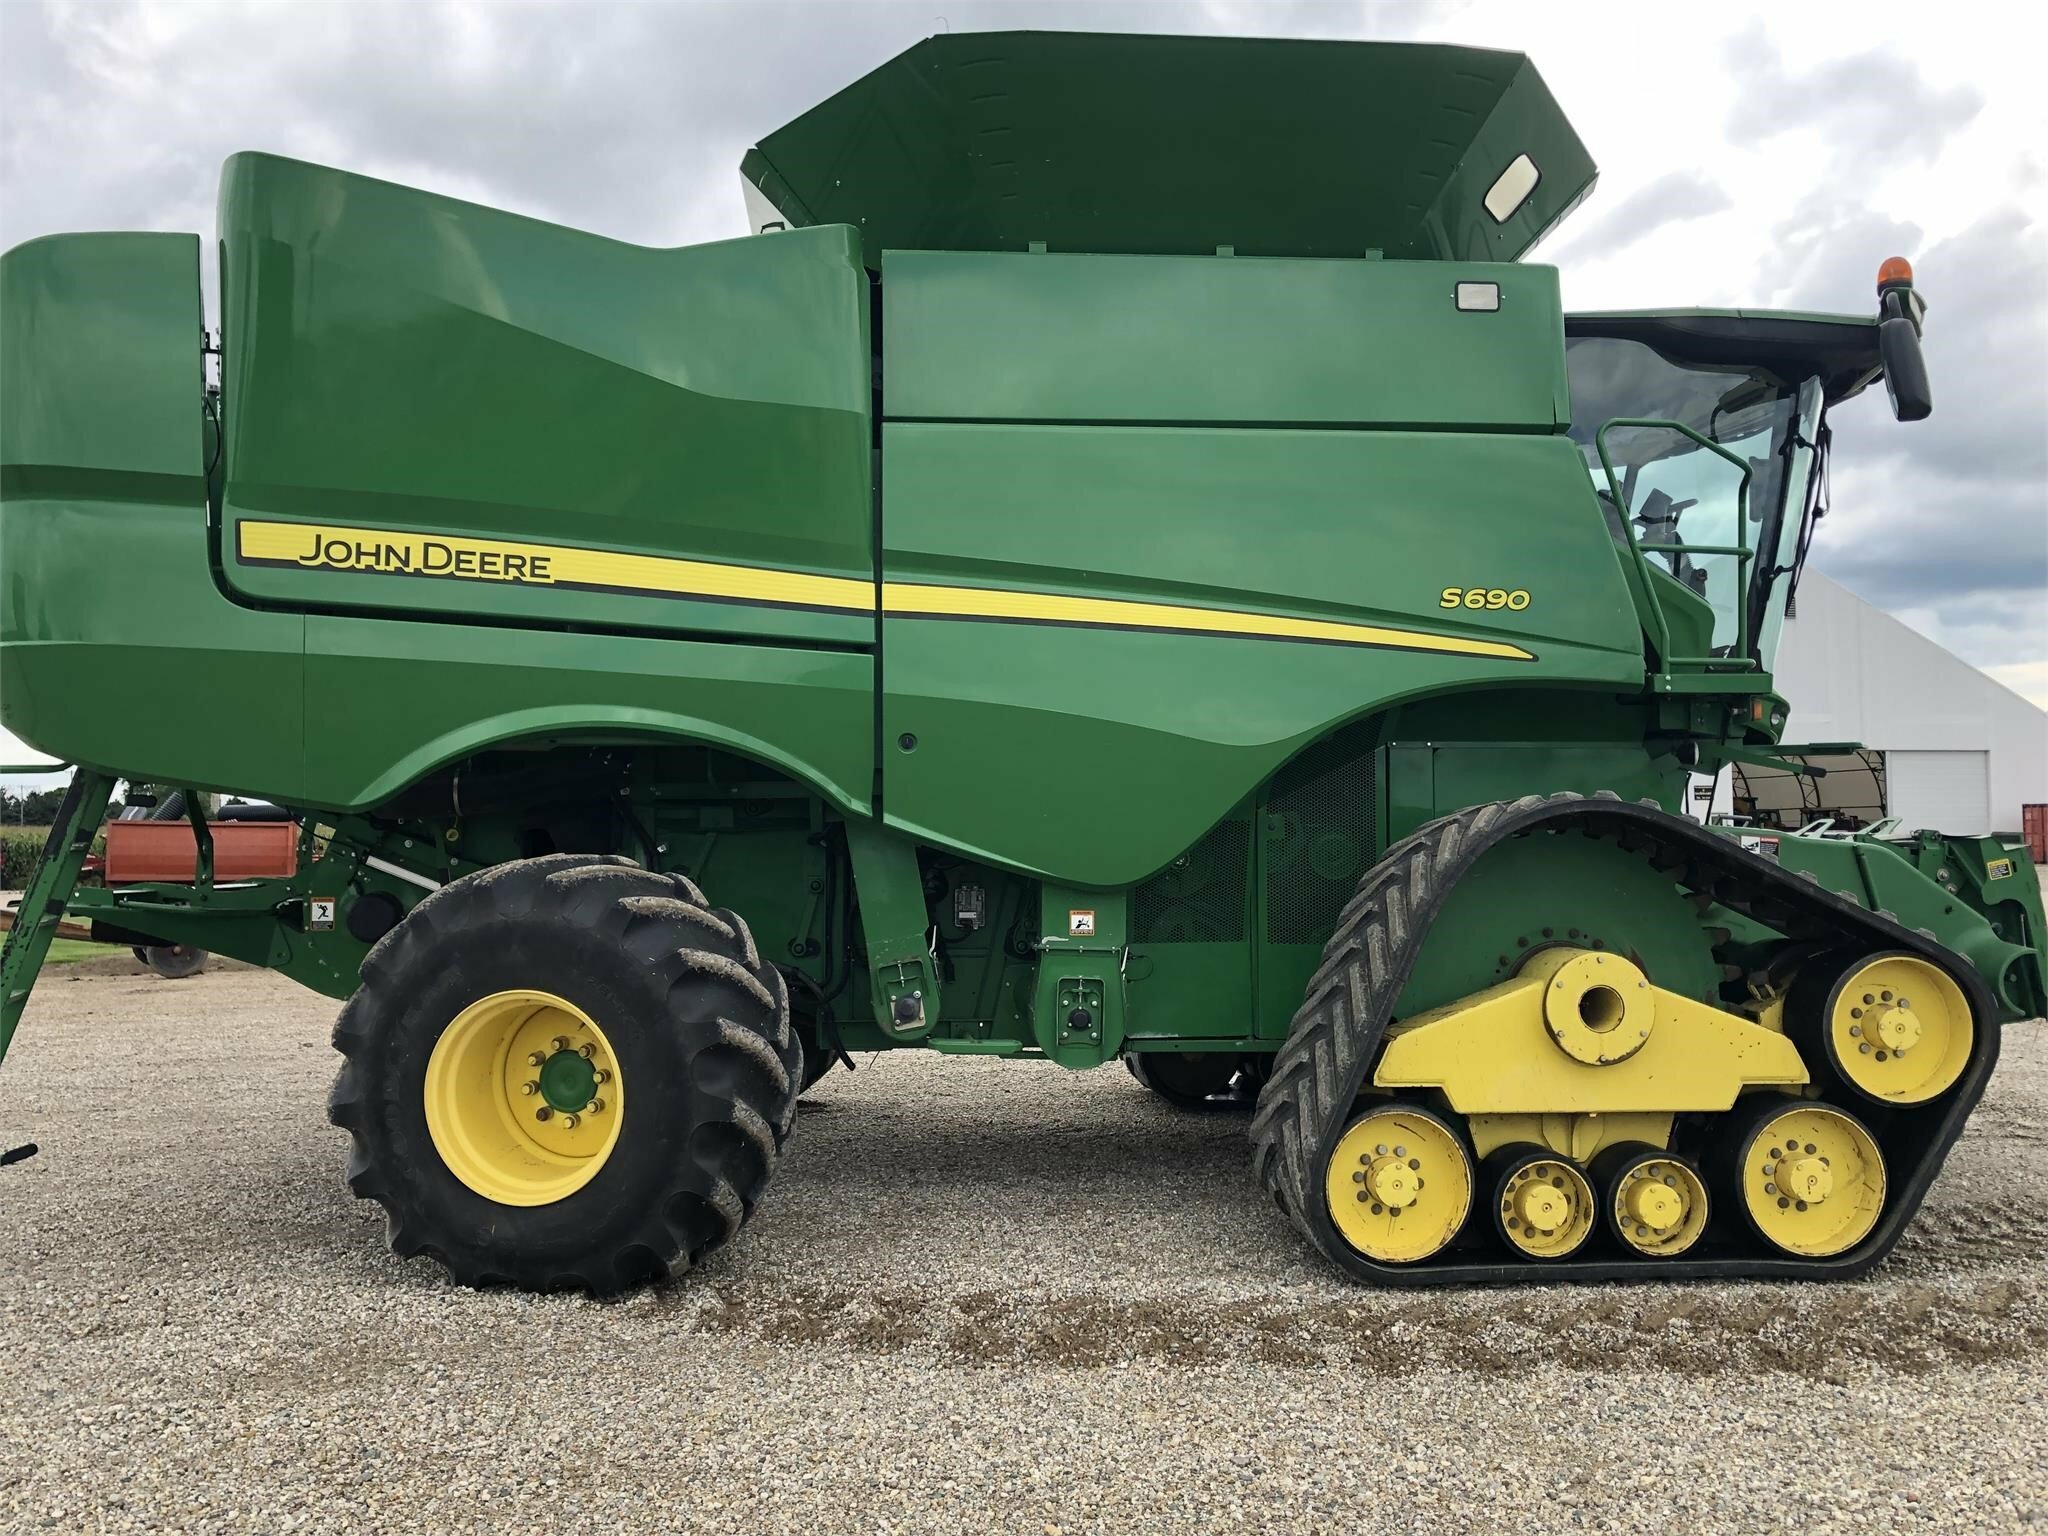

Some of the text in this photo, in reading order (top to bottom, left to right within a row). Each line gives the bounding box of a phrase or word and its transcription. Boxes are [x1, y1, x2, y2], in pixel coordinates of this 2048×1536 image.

[299, 534, 551, 579] JOHN DEERE
[1439, 587, 1531, 611] S690
